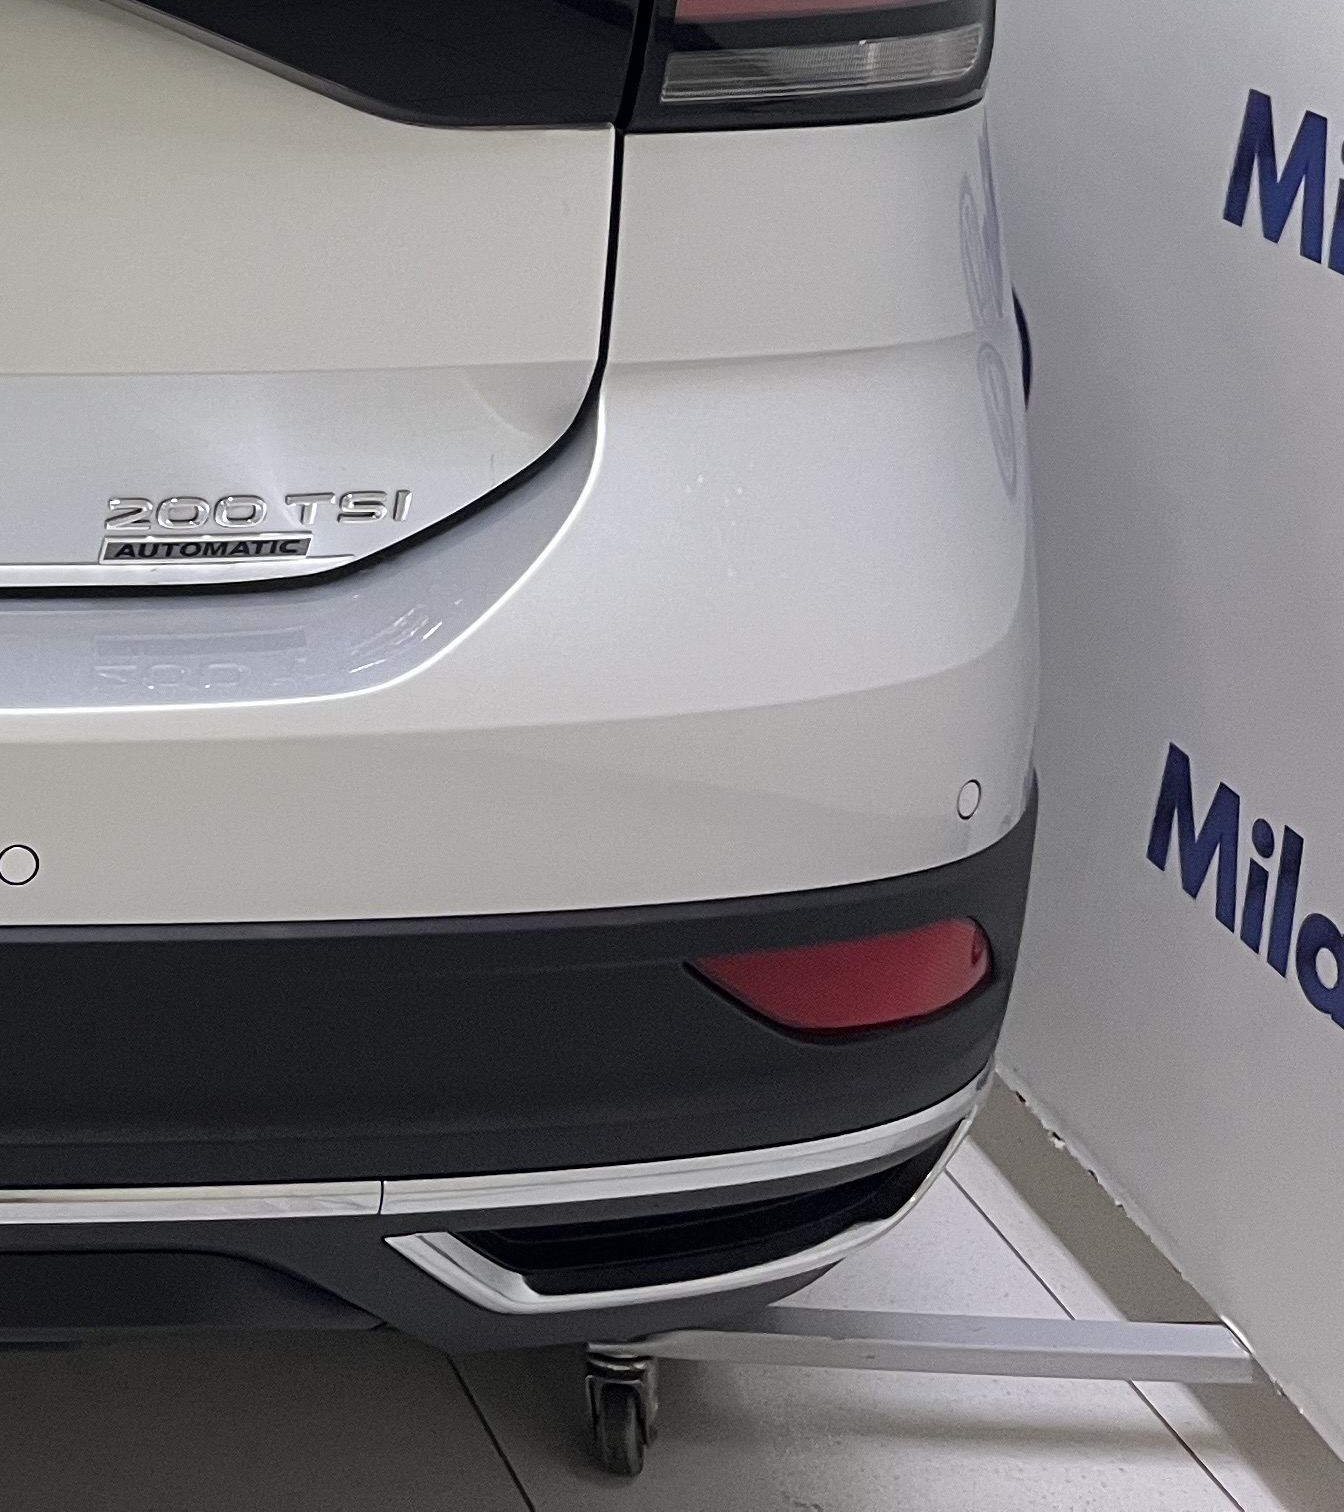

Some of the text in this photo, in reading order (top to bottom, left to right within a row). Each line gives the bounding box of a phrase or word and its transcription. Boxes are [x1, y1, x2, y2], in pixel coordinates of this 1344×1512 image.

[103, 488, 413, 531] 200 TSI
[114, 537, 302, 559] AUTOMATIC
